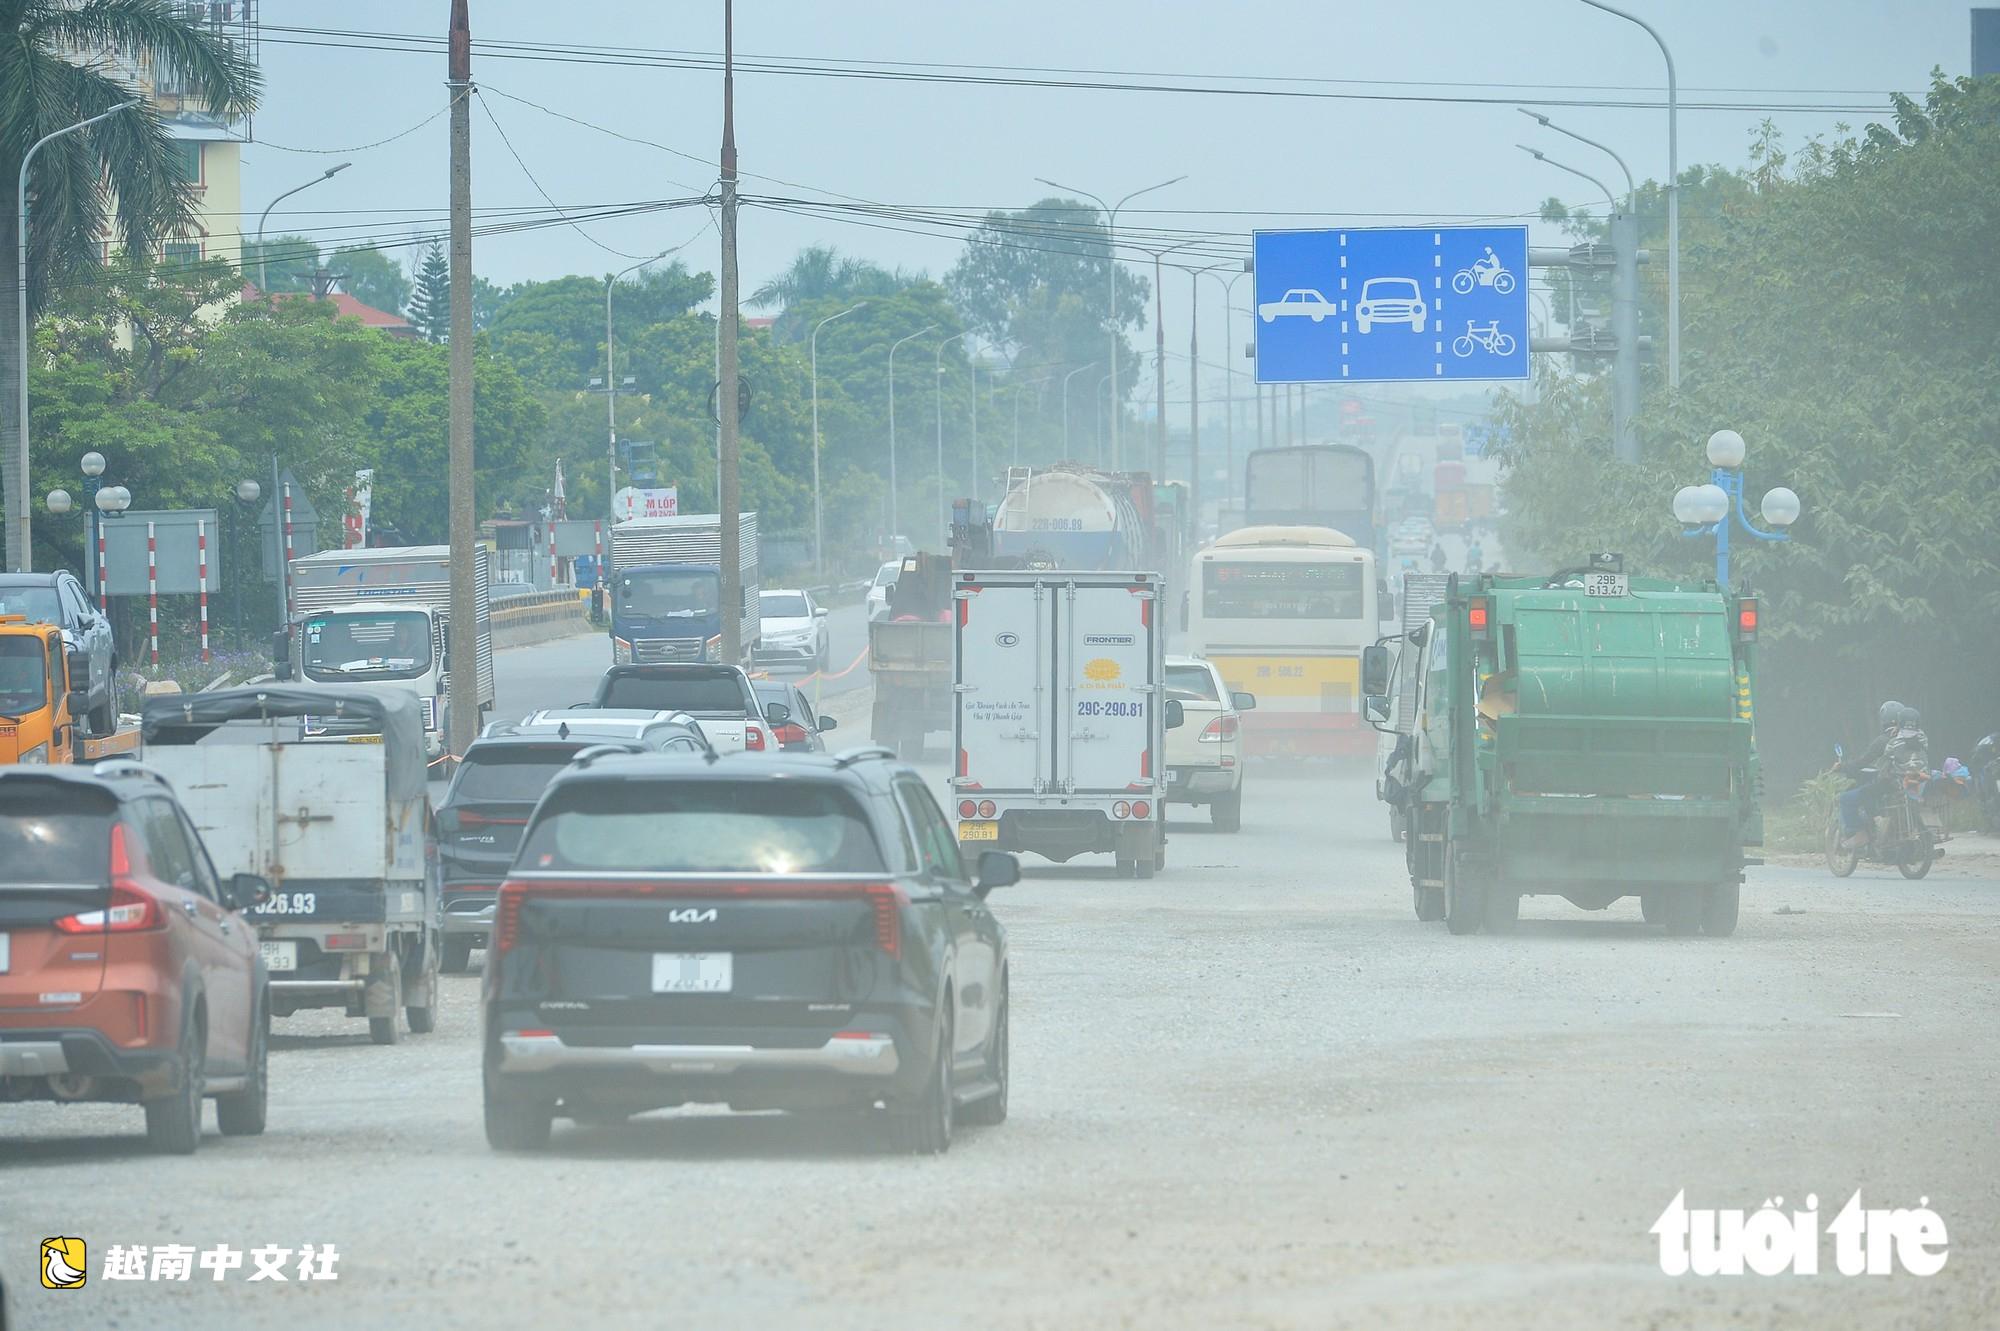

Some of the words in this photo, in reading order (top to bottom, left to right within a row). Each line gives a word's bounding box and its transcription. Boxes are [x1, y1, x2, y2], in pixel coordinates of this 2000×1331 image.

[1597, 575, 1616, 584] 29B
[1588, 586, 1623, 595] 613.47
[1077, 701, 1143, 718] 29C-290.81
[669, 909, 717, 923] KIA
[259, 943, 280, 956] 9H
